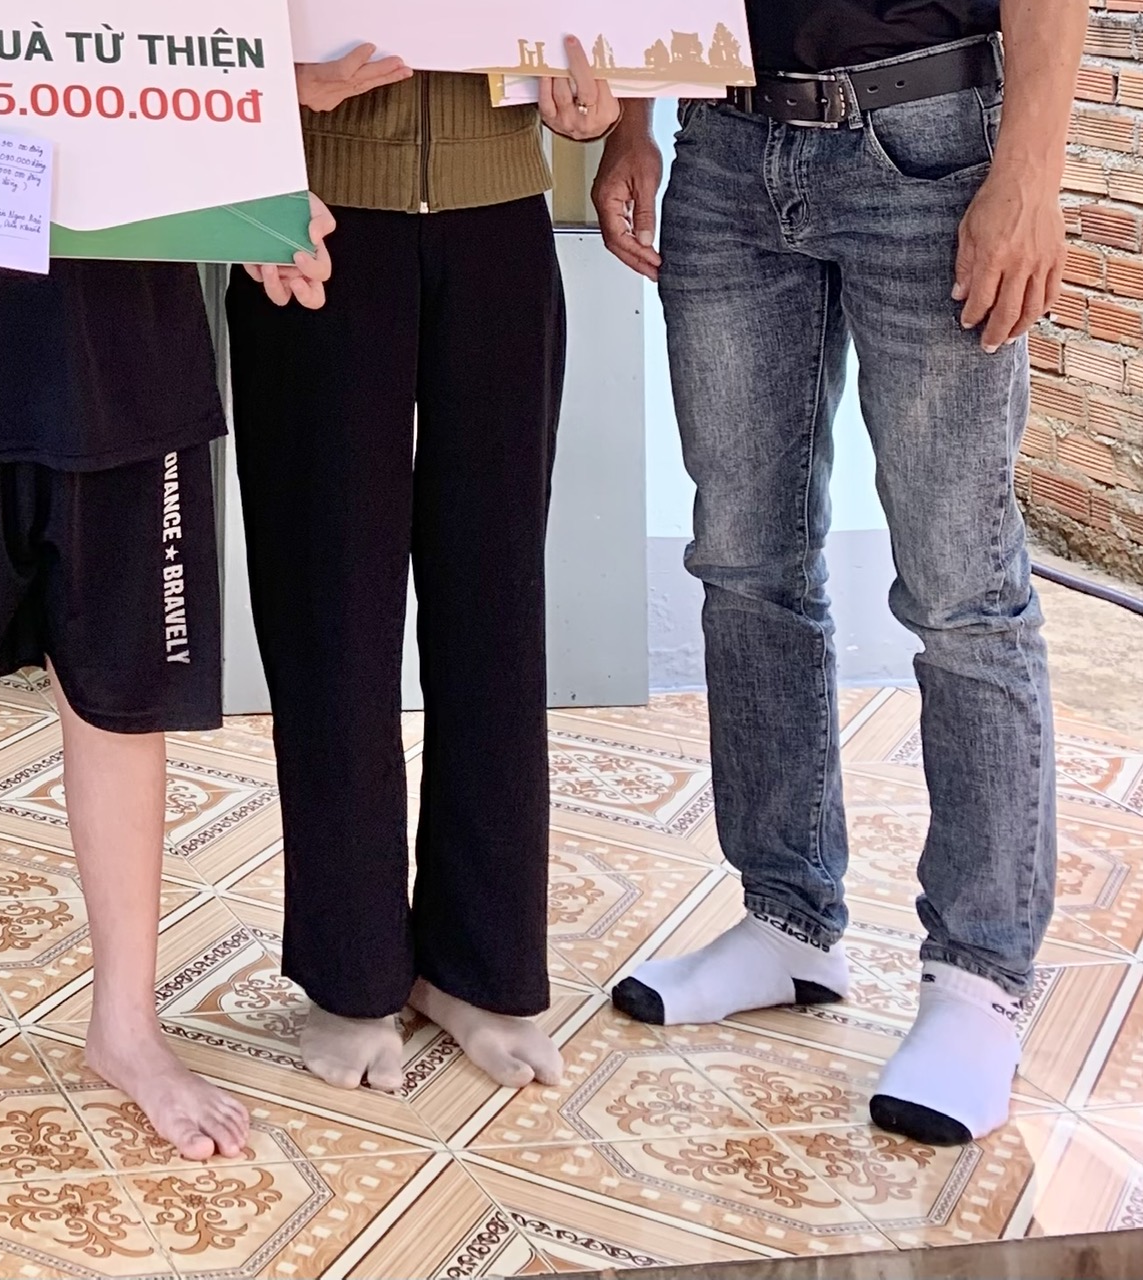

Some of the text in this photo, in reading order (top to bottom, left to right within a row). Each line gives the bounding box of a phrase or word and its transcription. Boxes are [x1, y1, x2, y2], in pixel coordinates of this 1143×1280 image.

[65, 23, 126, 65] TỪ
[138, 26, 265, 74] THIỆN
[163, 563, 191, 664] BRAVELY
